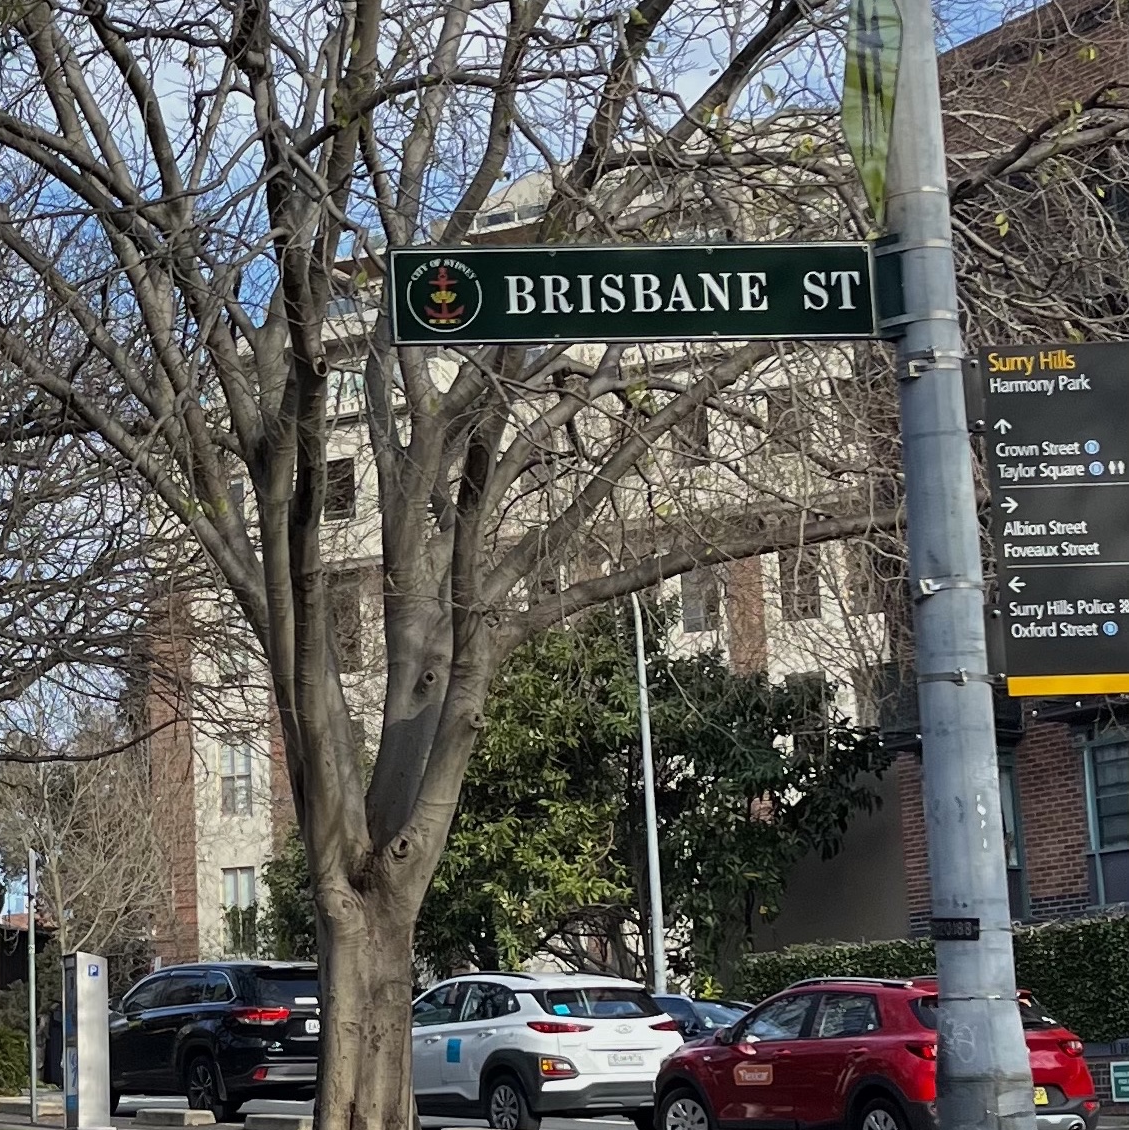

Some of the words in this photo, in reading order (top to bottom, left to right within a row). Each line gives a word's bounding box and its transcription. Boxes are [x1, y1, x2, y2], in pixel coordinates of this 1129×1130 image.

[504, 272, 769, 314] BRISBANE
[803, 270, 861, 310] ST
[988, 353, 1035, 376] Surry
[1039, 349, 1076, 370] Hills
[989, 377, 1056, 396] Harmony
[1058, 373, 1091, 391] Park
[995, 442, 1040, 457] Crown
[1041, 441, 1081, 456] Street
[997, 462, 1037, 482] Taylor
[1038, 462, 1085, 480] Square
[1003, 521, 1047, 536] Albion
[1048, 520, 1088, 535] Street
[1003, 543, 1059, 557] Foveaux
[1060, 541, 1100, 556] Street
[1009, 601, 1044, 620] Surry
[1046, 600, 1075, 615] Hills
[1076, 599, 1116, 615] Police
[1011, 621, 1058, 638] Oxford
[1059, 622, 1099, 637] Street
